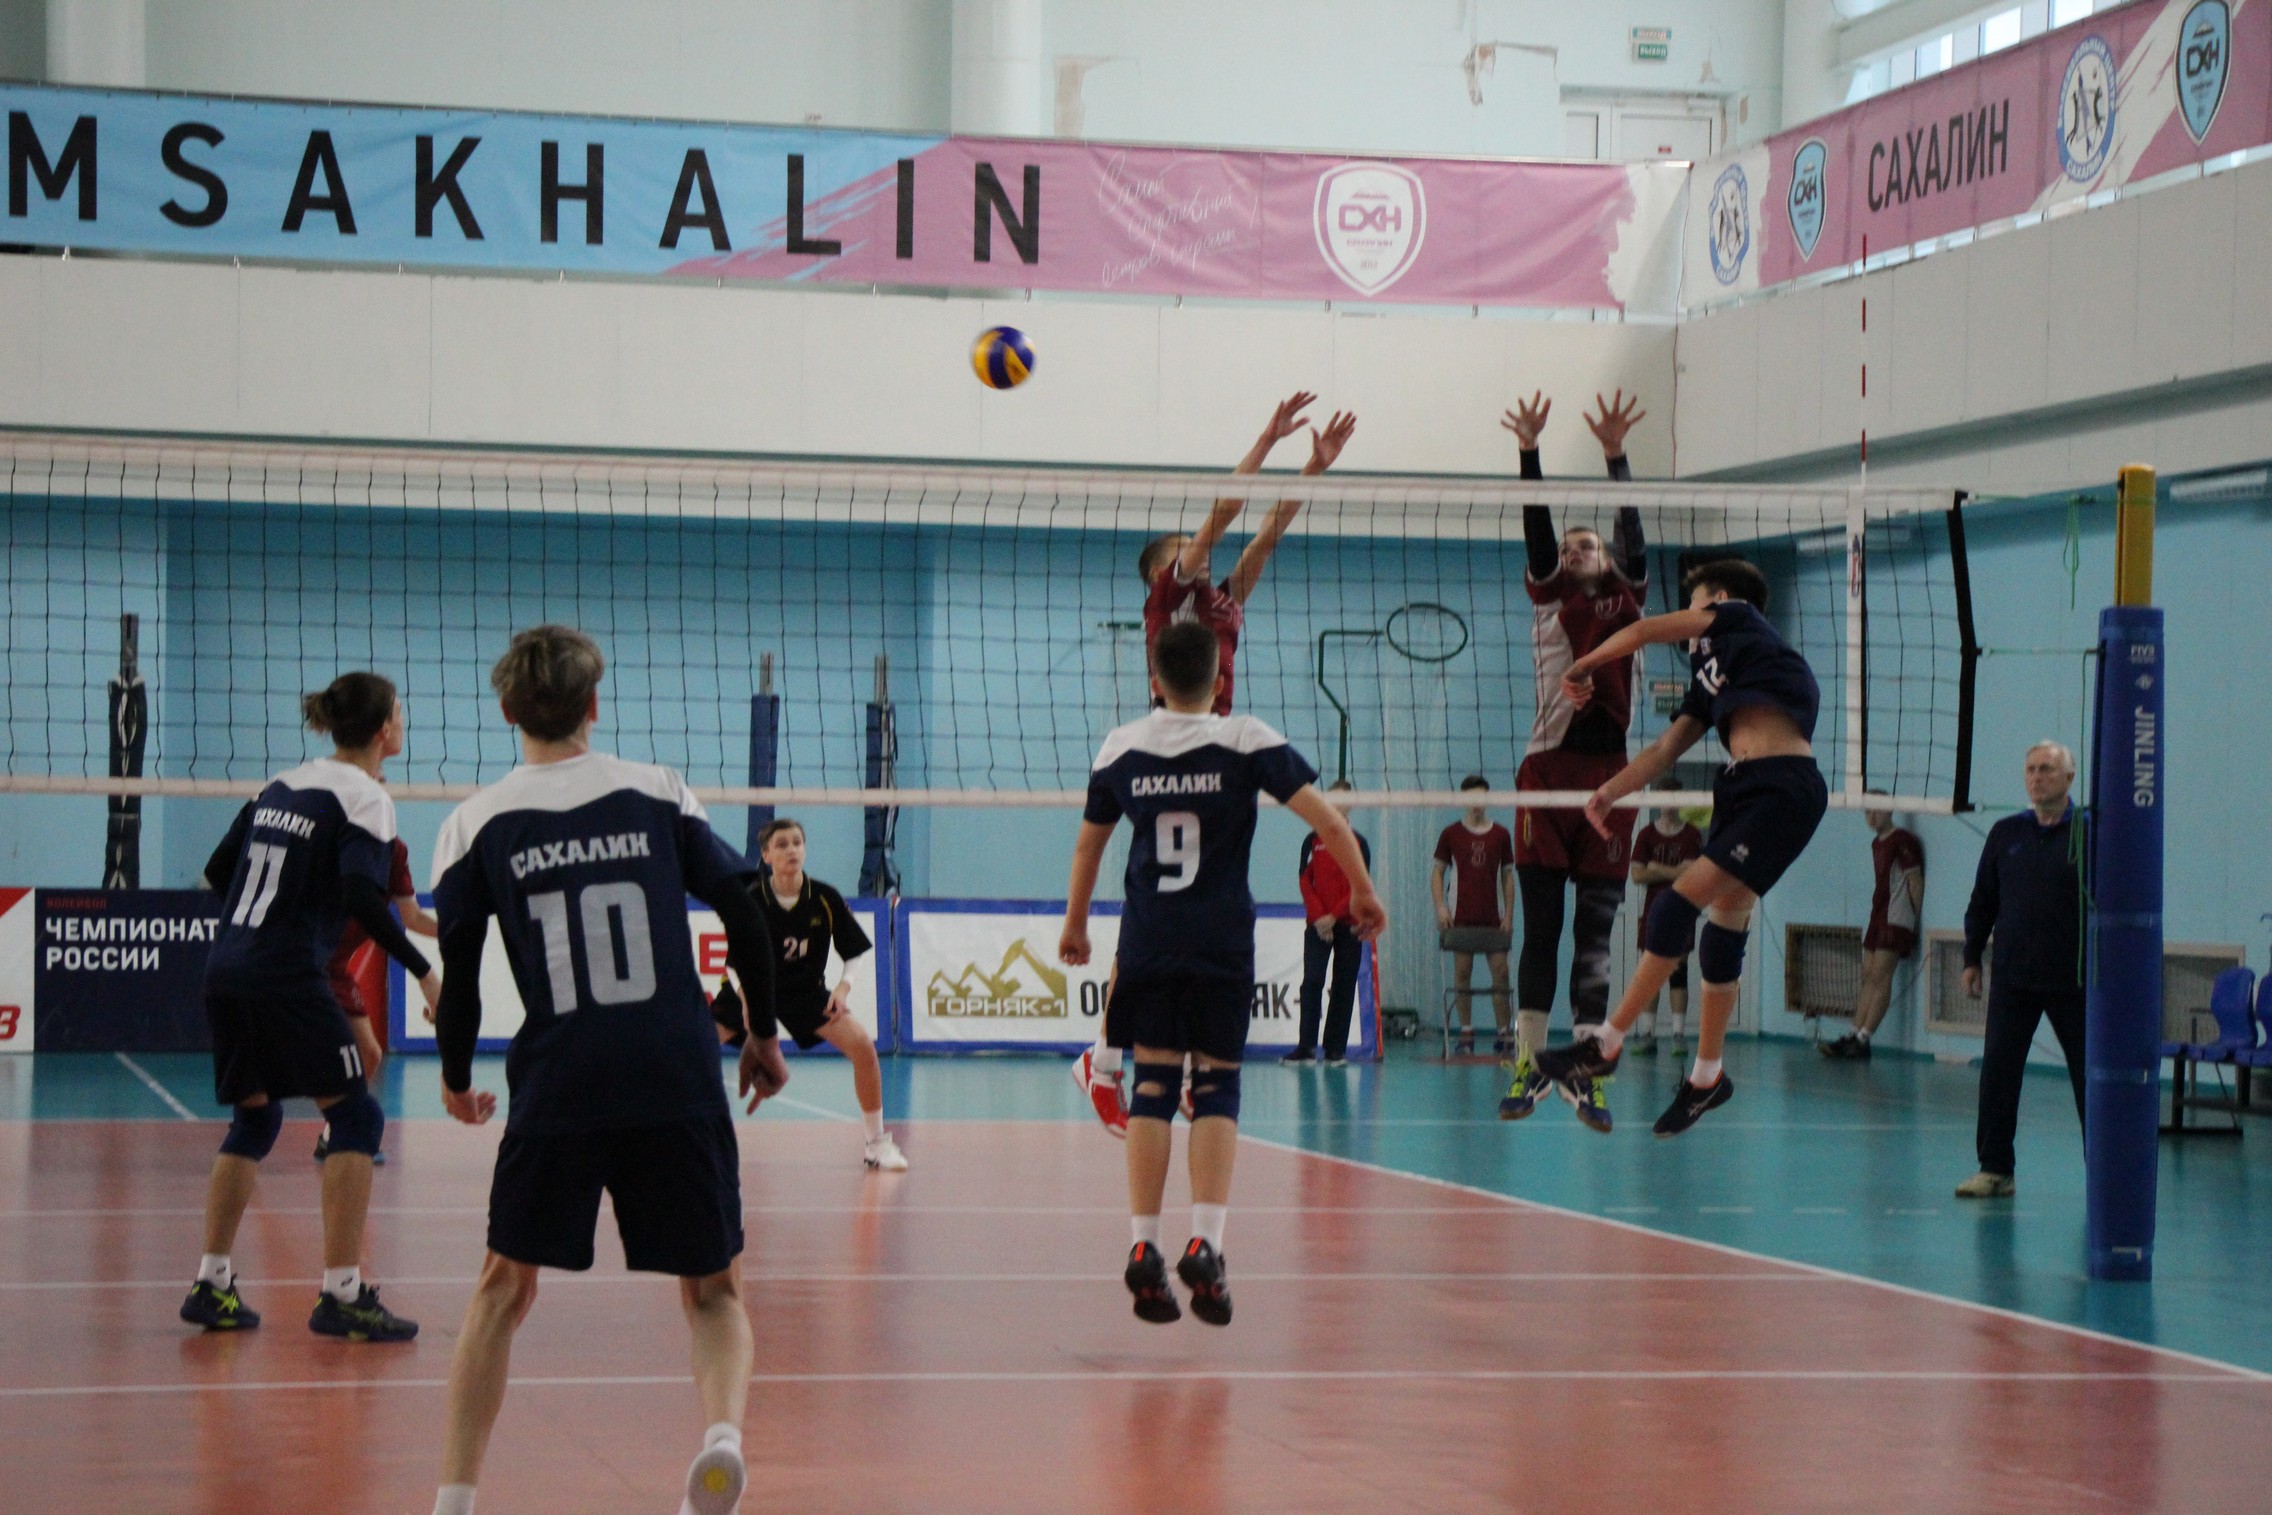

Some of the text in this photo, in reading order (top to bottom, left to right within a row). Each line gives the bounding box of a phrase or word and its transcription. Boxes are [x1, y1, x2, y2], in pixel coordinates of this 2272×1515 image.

[1868, 98, 2009, 212] САХАЛИН
[2133, 705, 2155, 807] JINLING
[1131, 773, 1222, 797] САХАЛИН
[510, 832, 651, 880] САХАЛИН
[1156, 811, 1200, 892] 9
[231, 842, 288, 928] 11
[45, 917, 219, 942] ЧЕМПИОНАТ
[527, 881, 657, 1016] 10
[46, 947, 160, 971] РОССИИ
[931, 996, 1066, 1016] ГОРНЯК-1
[340, 1045, 362, 1079] 11
